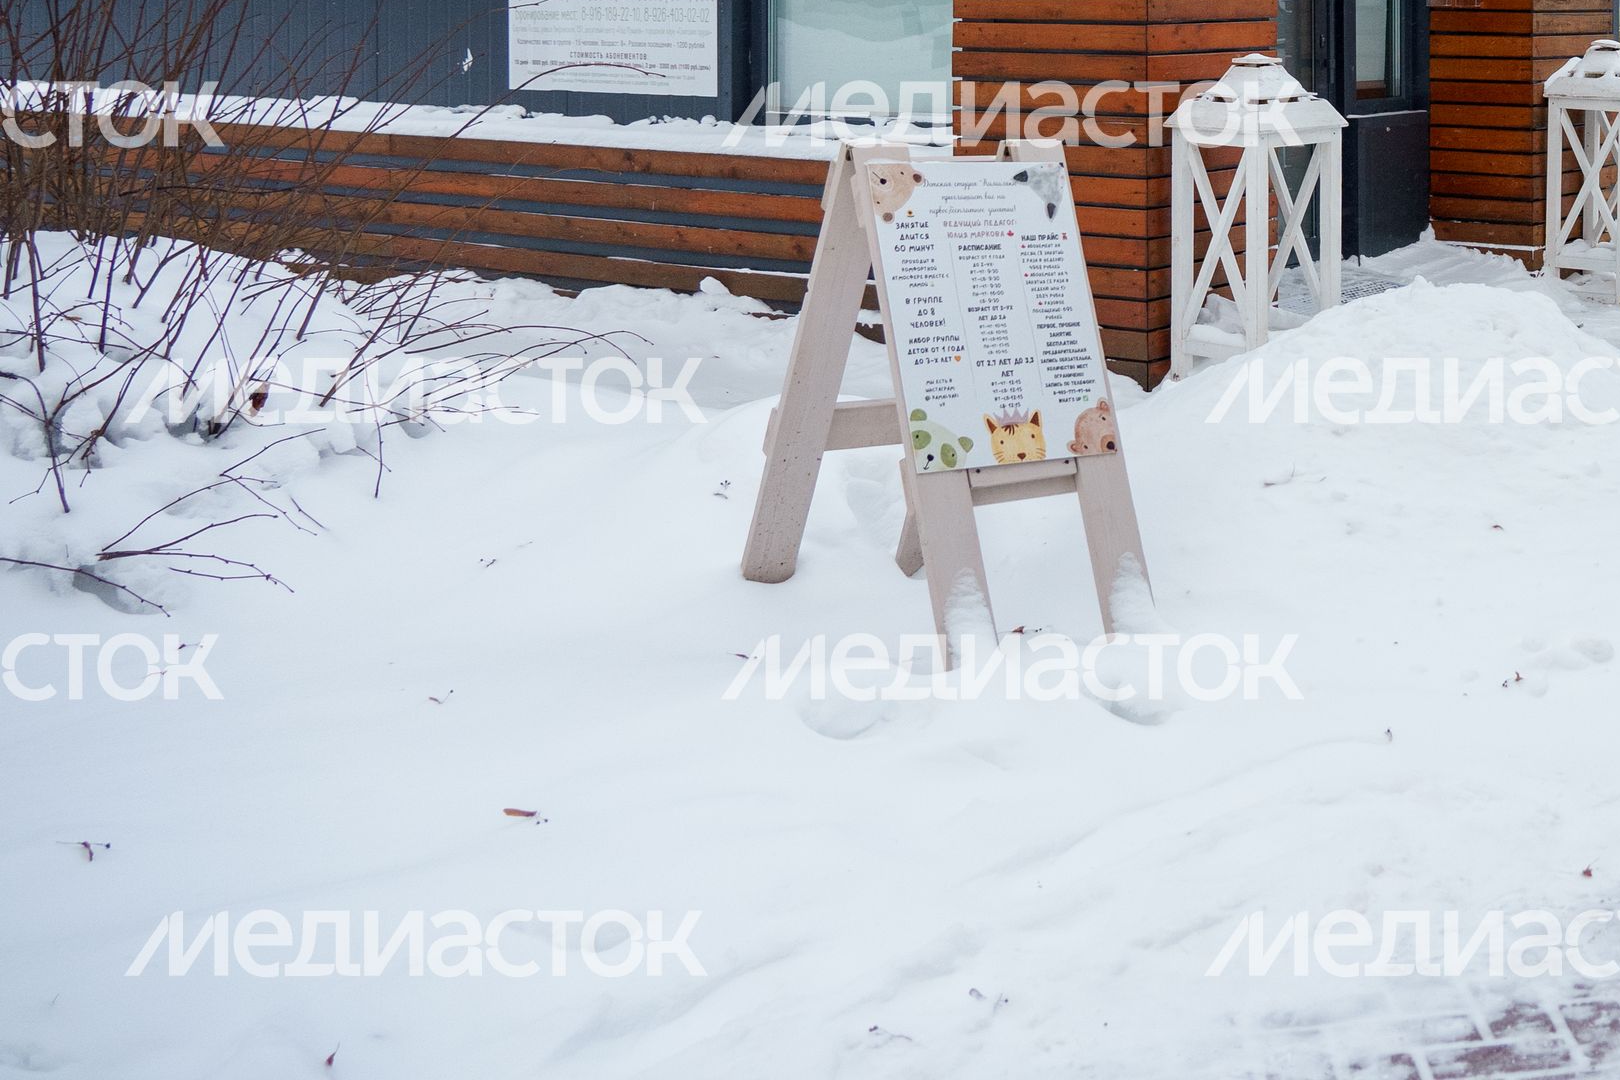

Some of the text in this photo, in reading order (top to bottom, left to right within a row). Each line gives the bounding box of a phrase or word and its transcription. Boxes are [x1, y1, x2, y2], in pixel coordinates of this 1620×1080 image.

[570, 51, 647, 61] СТОИМОСТЬ АБОНЕМЕНТОВ
[896, 221, 929, 230] ЗАНЯТИЕ
[943, 219, 981, 229] ВЕДУЩИЙ
[900, 233, 930, 241] ДЛИТСЯ
[947, 230, 1005, 239] ЮЛИЯ МАРКОВА
[1038, 232, 1059, 240] ПРАЙС
[909, 244, 935, 253] МИНУТ
[913, 296, 943, 304] ГРУППЕ
[910, 317, 946, 329] ЧЕЛОВЕК!
[933, 335, 960, 343] ГРУППЫ
[907, 347, 929, 355] ДЕТОК
[1014, 357, 1023, 365] ДО
